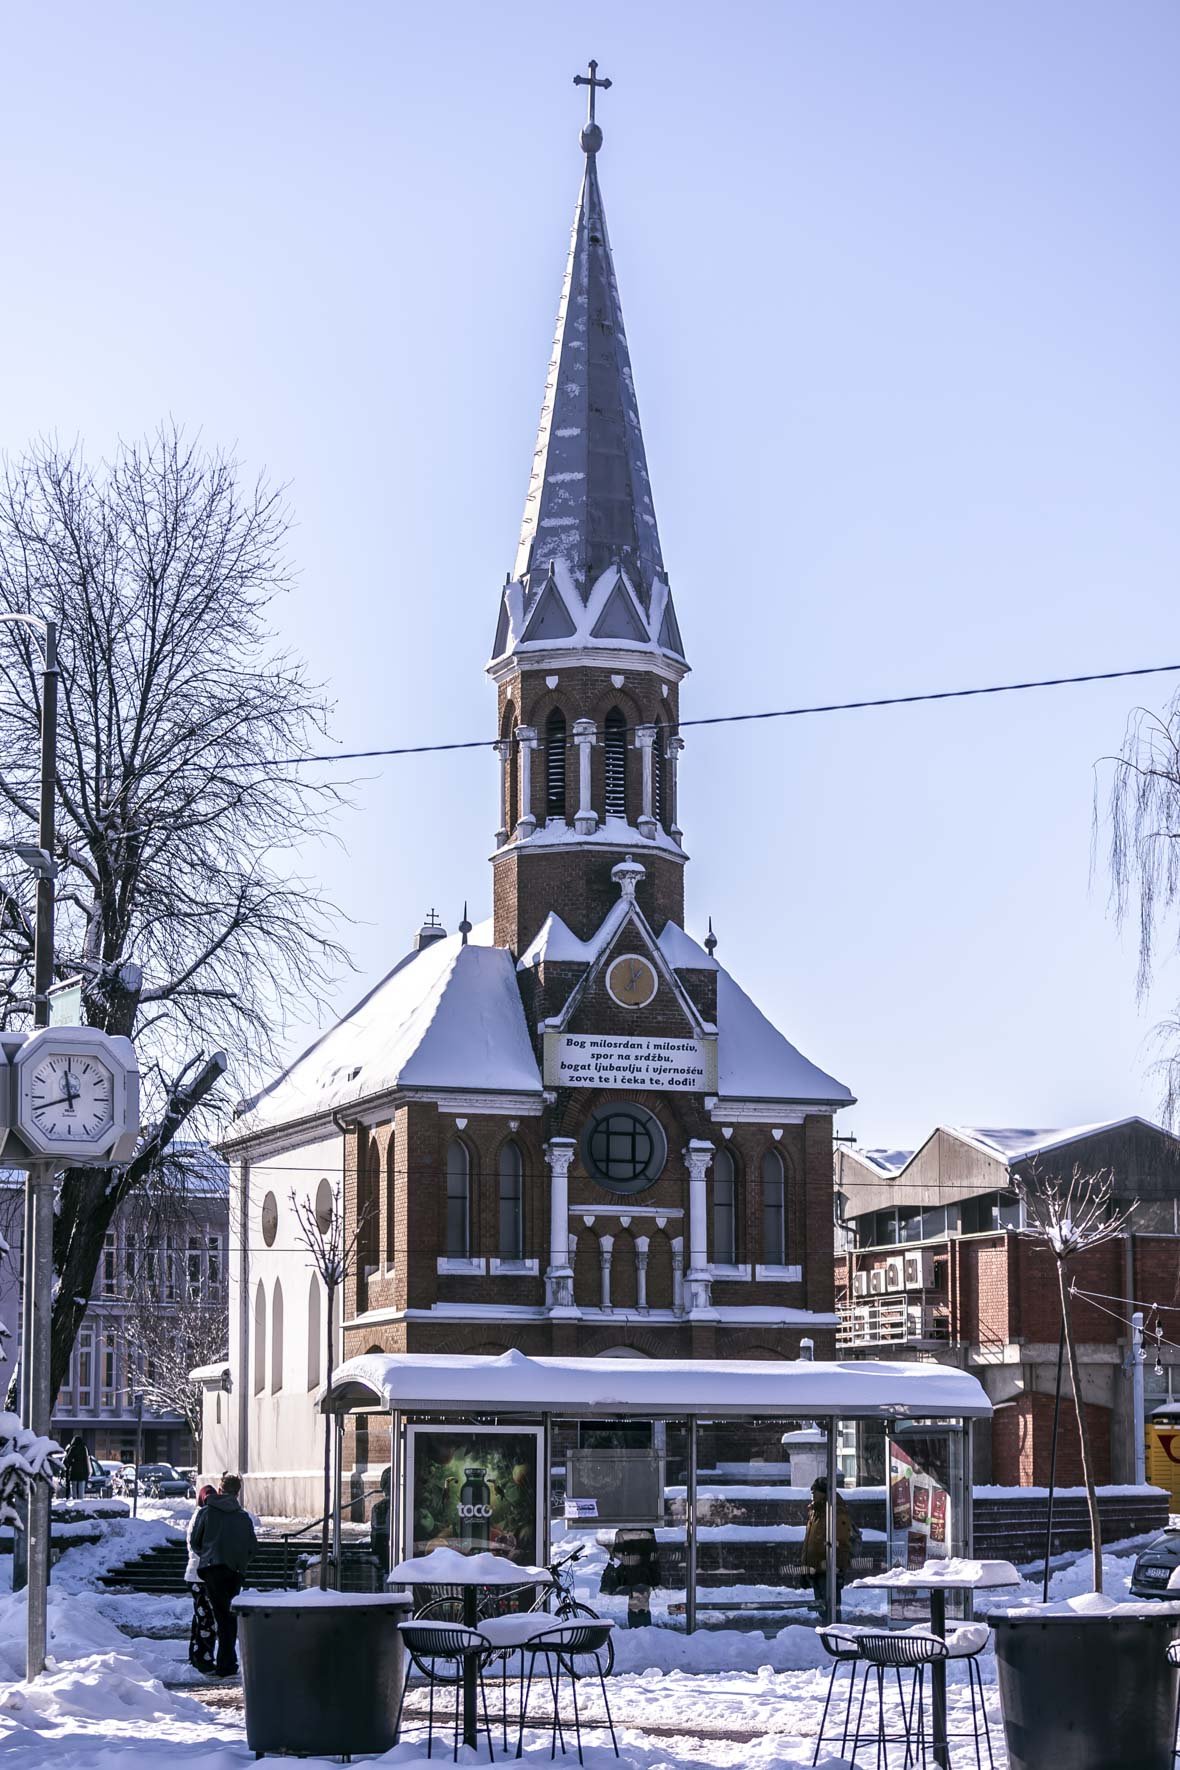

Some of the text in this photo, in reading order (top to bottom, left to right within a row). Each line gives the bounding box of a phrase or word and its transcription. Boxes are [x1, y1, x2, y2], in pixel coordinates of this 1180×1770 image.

[566, 1038, 698, 1053] Bog milosrdan i milostiv,
[590, 1053, 614, 1061] spor
[633, 1053, 674, 1063] srdžbu,
[560, 1061, 703, 1075] bogat ljubavlju i vjernošću
[568, 1075, 595, 1083] zove
[598, 1075, 610, 1083] te
[613, 1075, 617, 1083] i
[620, 1075, 646, 1085] čeka
[649, 1077, 665, 1086] te,
[456, 1502, 493, 1517] toco
